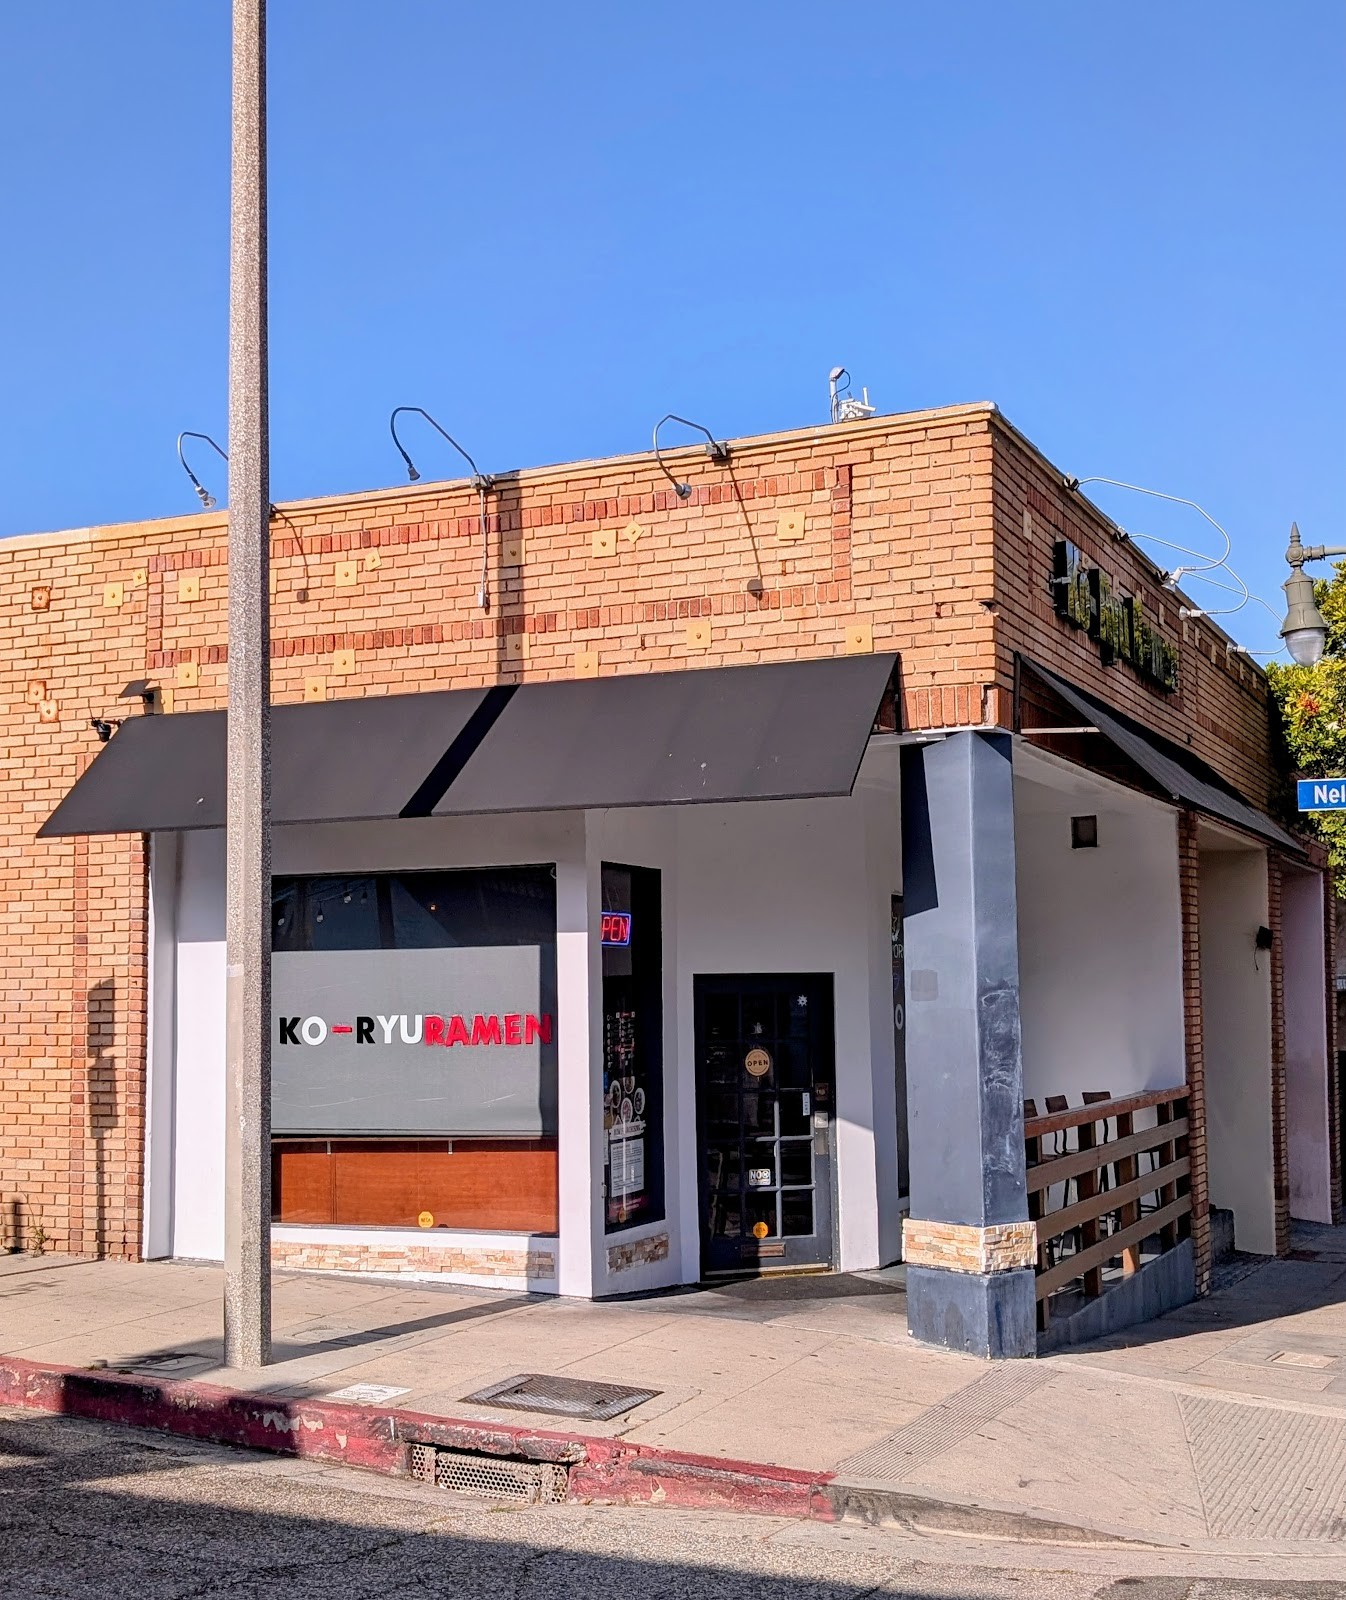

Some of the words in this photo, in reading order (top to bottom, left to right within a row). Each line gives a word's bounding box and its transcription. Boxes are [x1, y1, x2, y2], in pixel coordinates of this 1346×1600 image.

[1314, 784, 1346, 804] Nel
[601, 916, 628, 941] PEN
[424, 1013, 552, 1047] RAMEN
[747, 1059, 769, 1067] OPEN
